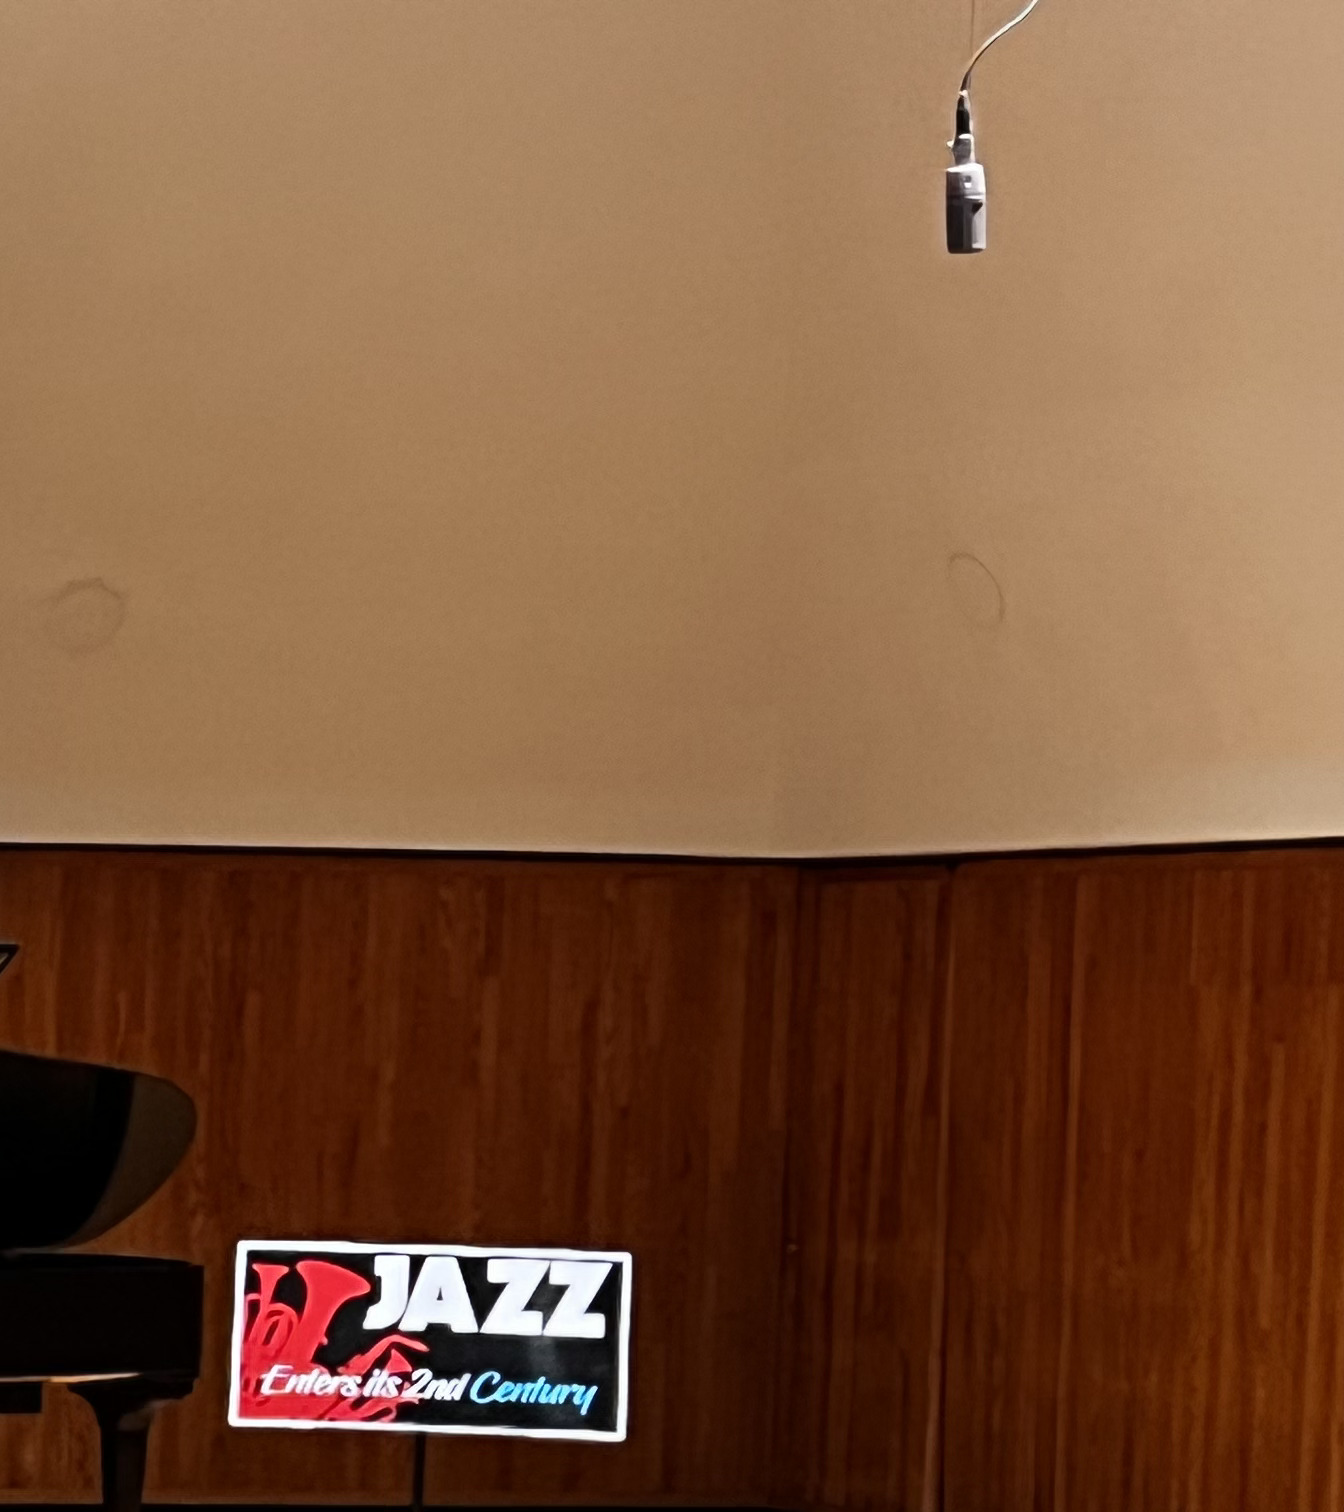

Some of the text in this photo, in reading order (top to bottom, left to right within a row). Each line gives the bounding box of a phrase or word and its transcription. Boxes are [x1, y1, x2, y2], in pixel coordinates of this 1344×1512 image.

[362, 1254, 614, 1339] JAZZ
[260, 1364, 599, 1416] Enters its 2nd Century
